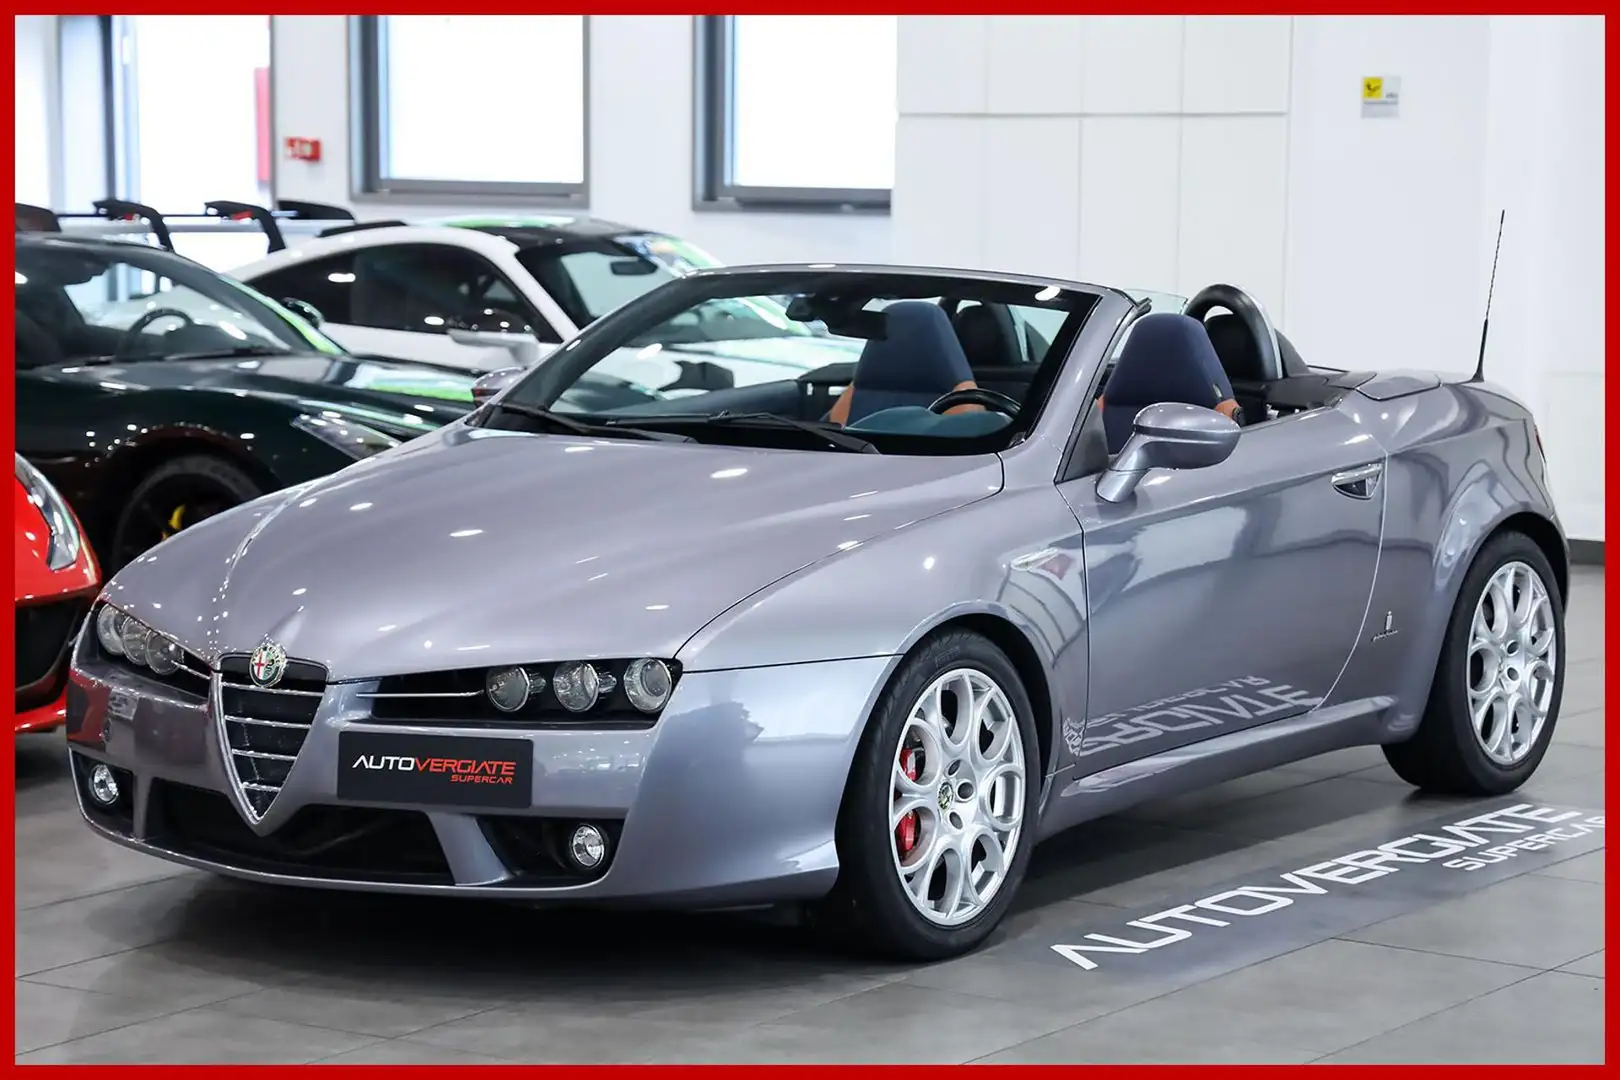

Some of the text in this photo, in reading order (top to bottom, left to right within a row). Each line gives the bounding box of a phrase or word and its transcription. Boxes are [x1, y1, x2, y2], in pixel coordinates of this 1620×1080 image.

[352, 754, 516, 775] AUTOVERGIATE
[450, 774, 513, 785] SUPERCAR
[1049, 803, 1582, 970] AUTOVERGIATE
